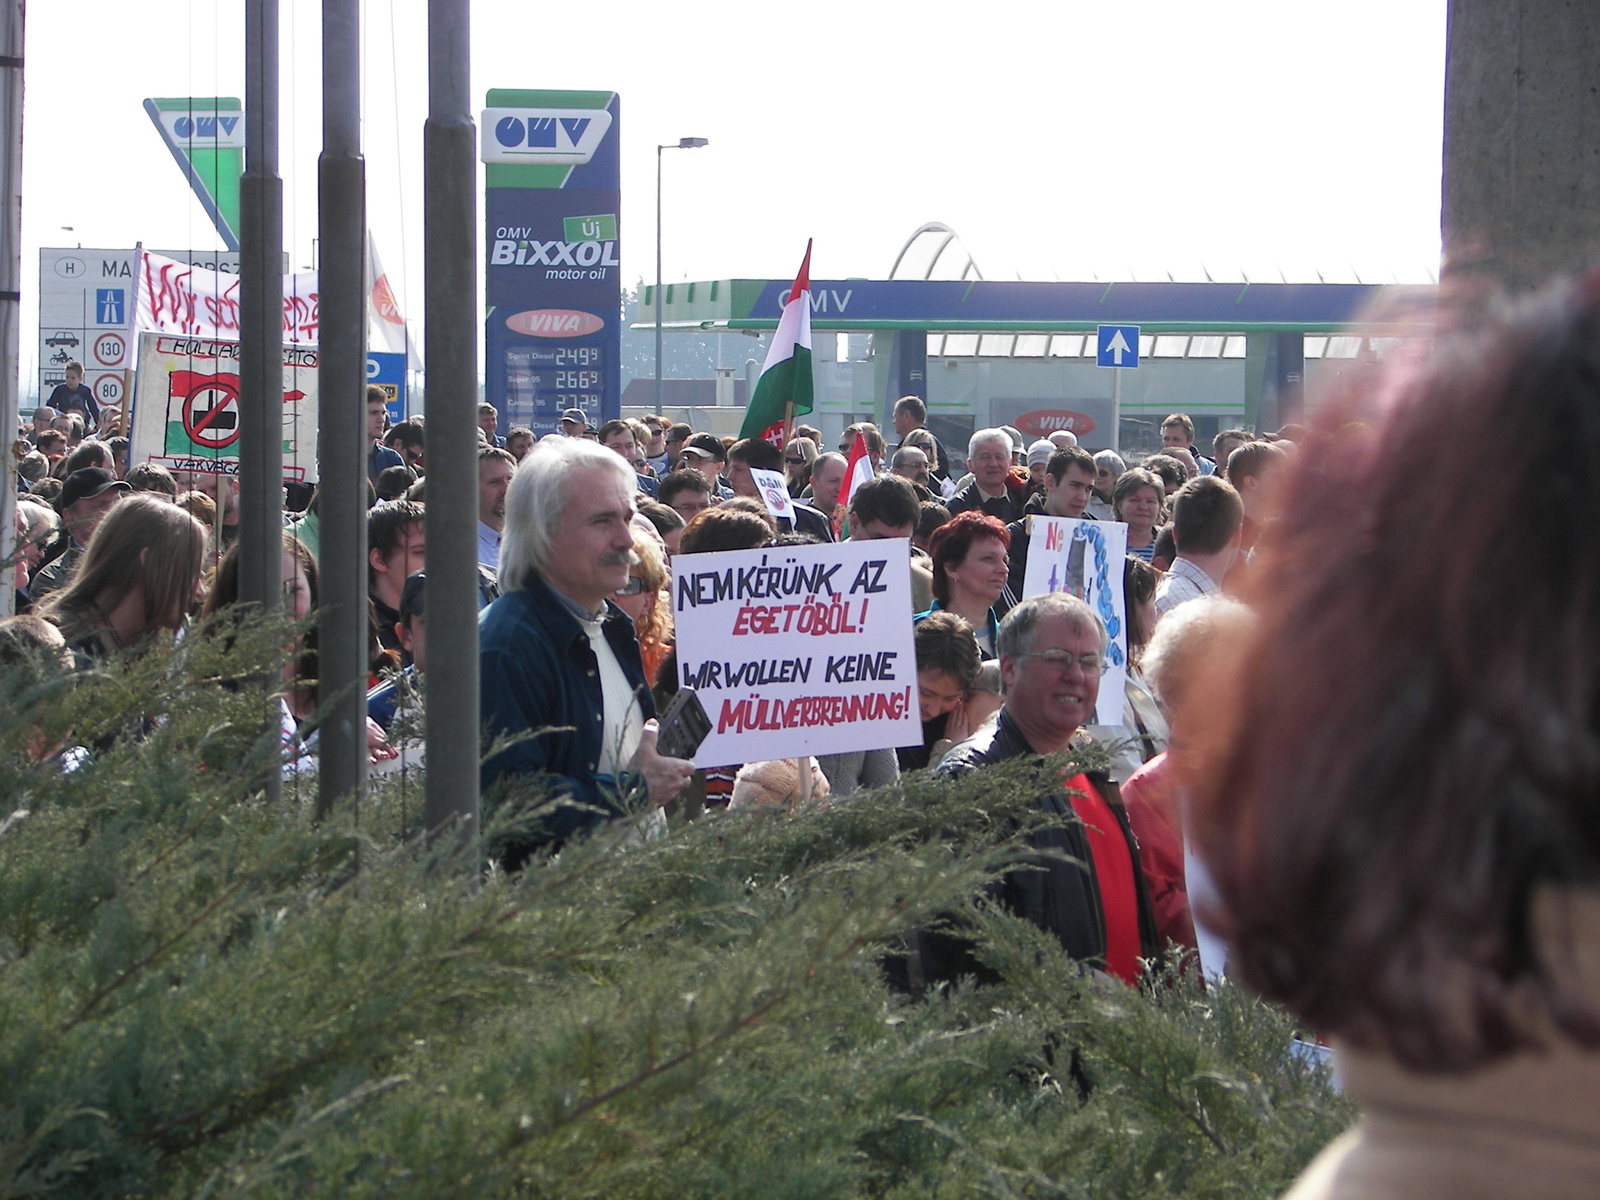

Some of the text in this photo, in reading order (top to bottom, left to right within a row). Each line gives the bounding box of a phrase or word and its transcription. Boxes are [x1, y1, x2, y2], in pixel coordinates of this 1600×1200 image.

[495, 116, 592, 148] OMV
[496, 227, 532, 239] OMV
[582, 218, 600, 239] Új
[66, 263, 75, 274] H
[545, 268, 606, 280] motor oil
[529, 314, 581, 332] VIVA
[100, 342, 121, 357] 130
[532, 352, 554, 360] Diesel
[531, 375, 541, 383] 95
[102, 384, 118, 398] 80
[1040, 415, 1075, 430] VIVA
[1046, 522, 1065, 553] Ne
[678, 554, 888, 611] NEM KÉRÜNK AZ
[683, 651, 898, 691] WIR WOLLEN KEINE
[716, 685, 912, 735] MÜLLVERBRENNUNG!
